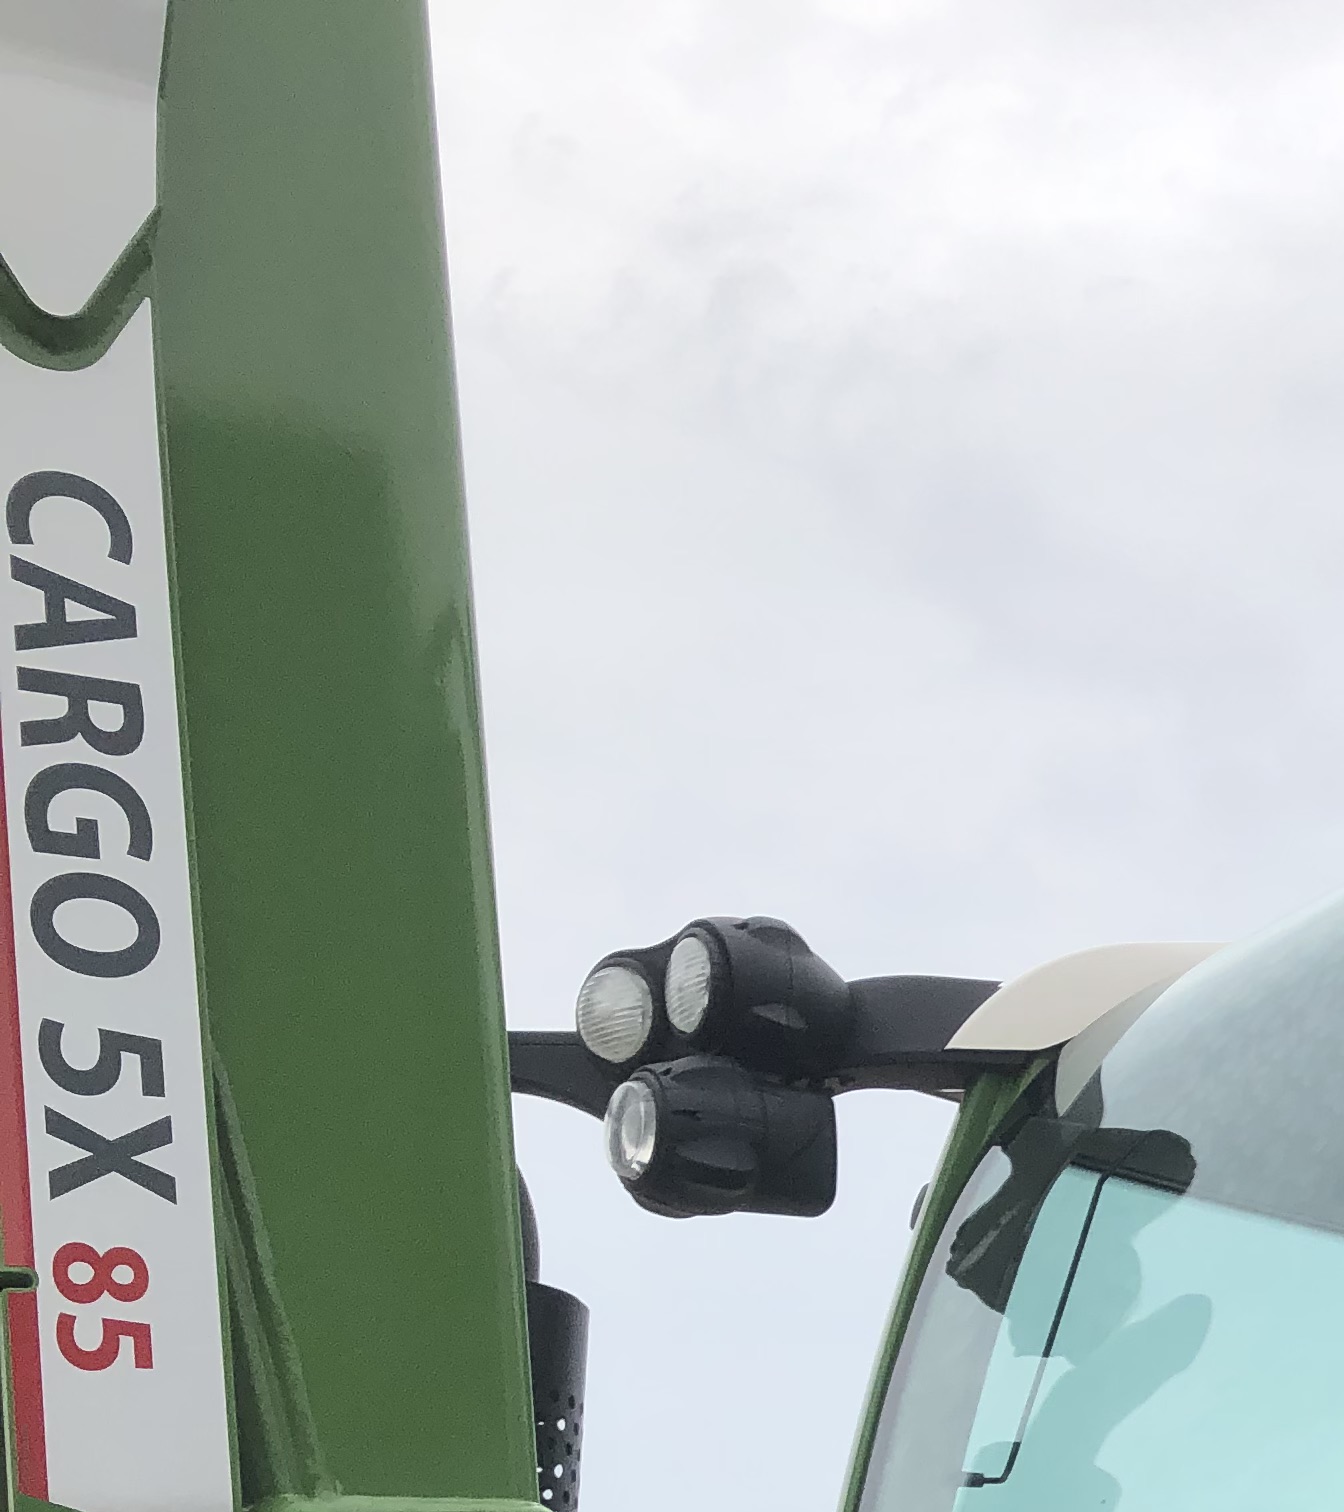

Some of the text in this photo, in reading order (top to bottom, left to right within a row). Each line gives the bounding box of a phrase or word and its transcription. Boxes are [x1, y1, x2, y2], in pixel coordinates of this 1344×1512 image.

[6, 470, 178, 1371] CARGO 5X 85
